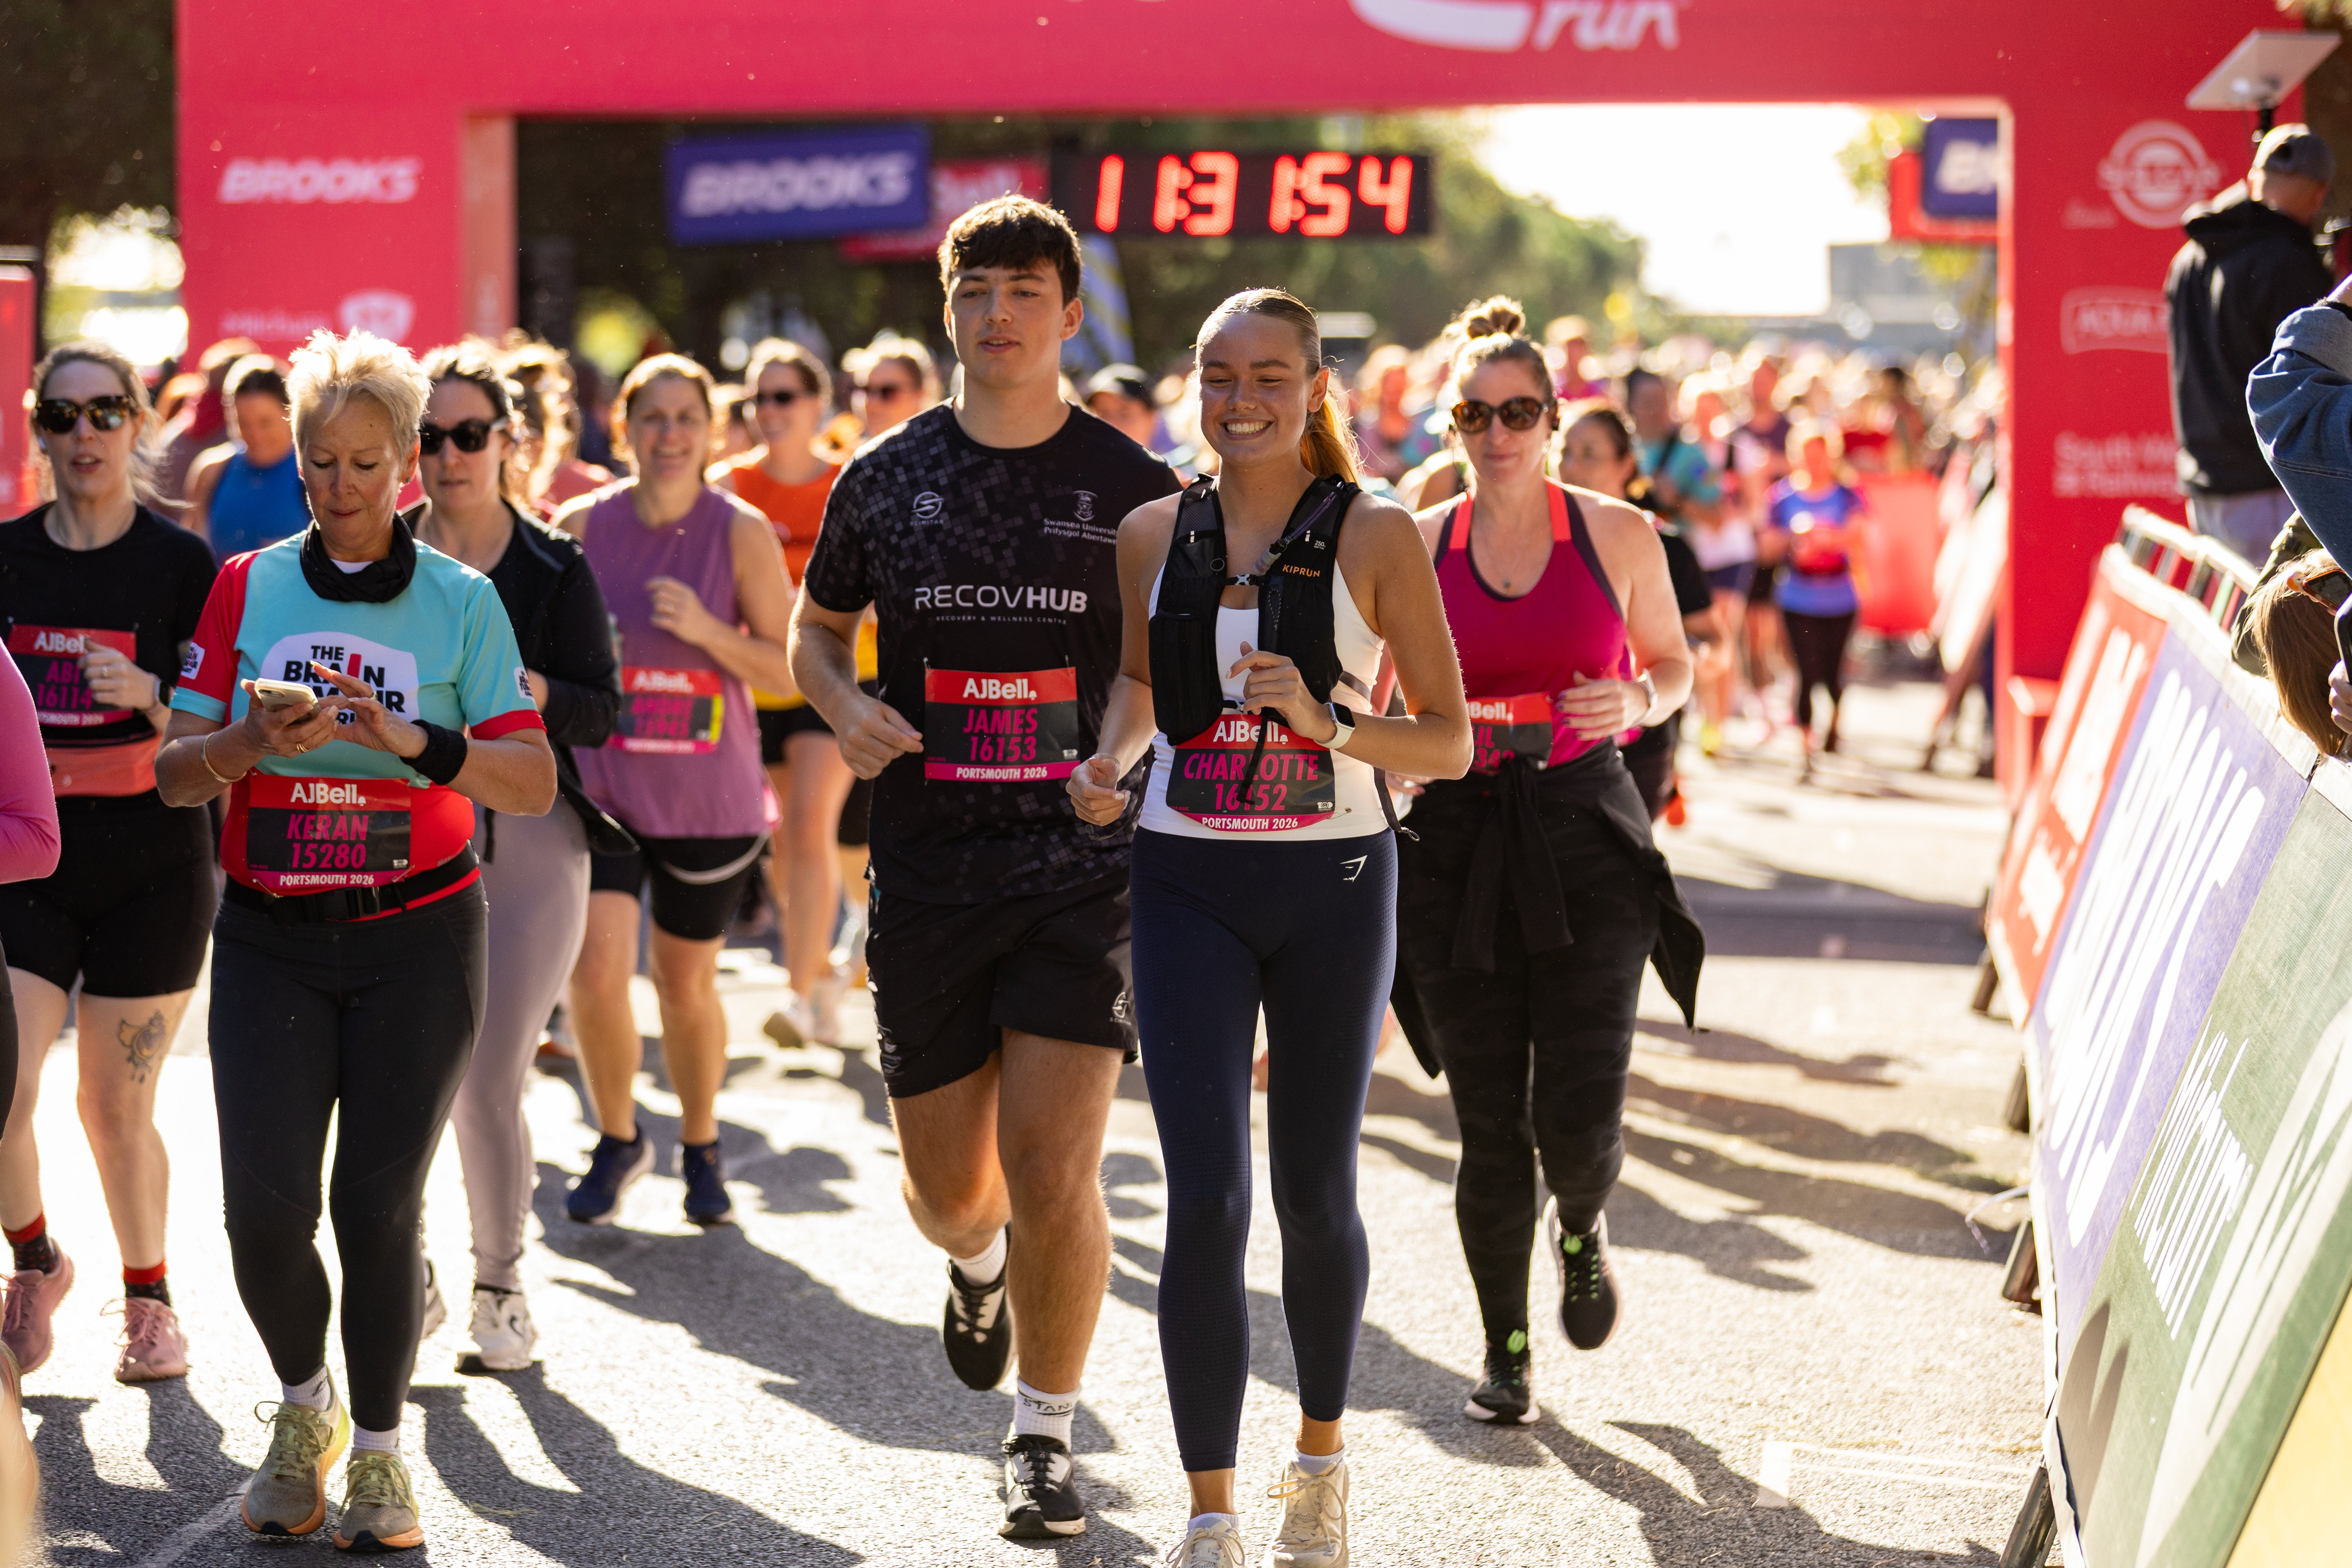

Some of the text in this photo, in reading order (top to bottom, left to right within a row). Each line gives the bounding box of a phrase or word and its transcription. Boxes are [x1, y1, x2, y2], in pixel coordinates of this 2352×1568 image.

[219, 157, 421, 204] BROOKS
[682, 151, 919, 218] BROOKS
[1043, 518, 1117, 536] Swansea Universit
[1043, 526, 1079, 538] Prifysgol
[1282, 564, 1320, 577] KIPRUN
[915, 585, 1087, 613] RECOVHUB
[1037, 617, 1067, 625] CENTRE
[34, 631, 86, 654] AJBel
[311, 645, 344, 661] THE
[46, 660, 81, 684] ABI
[37, 683, 93, 709] 16114
[963, 678, 1028, 699] AJBell
[963, 708, 1038, 734] JAMES
[970, 735, 1037, 762] 16153
[956, 766, 1048, 779] PORTSMOUTH 2026
[1184, 753, 1318, 780] CHAROTTE
[290, 783, 358, 804] AJBell
[287, 814, 369, 841] KERAN
[1202, 817, 1298, 830] PORTSMOUTH 2026
[292, 842, 366, 869] 15280
[280, 874, 374, 886] PORTSMOUTH 2026
[2045, 670, 2265, 1247] BROOKS
[1023, 1398, 1072, 1412] STAN
